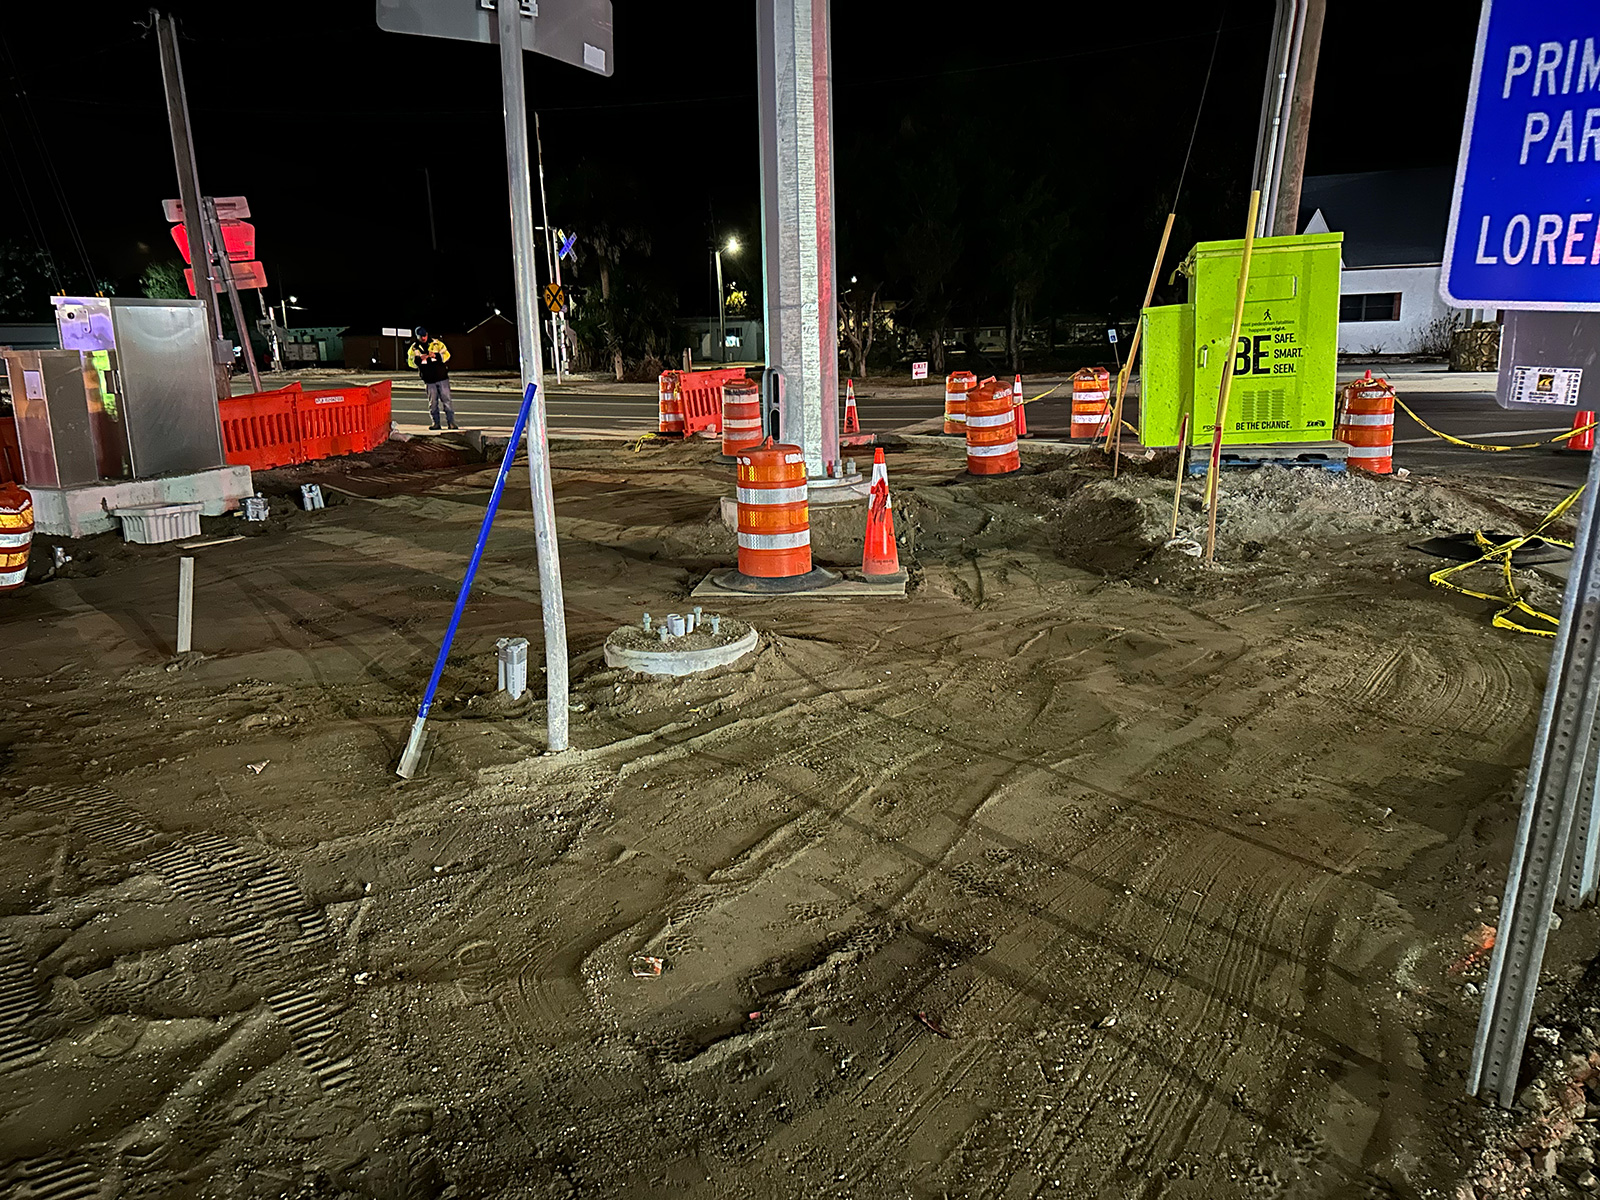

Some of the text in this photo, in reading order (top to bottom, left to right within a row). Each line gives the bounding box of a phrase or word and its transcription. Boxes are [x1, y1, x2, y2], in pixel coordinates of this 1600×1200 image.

[1502, 37, 1600, 99] PRIM
[1519, 107, 1600, 165] PAR
[1475, 213, 1600, 265] LORE
[1274, 333, 1296, 343] SAFE.
[1233, 334, 1272, 376] BE
[1273, 347, 1303, 359] SMART.
[1273, 363, 1296, 374] SEEN.
[1235, 420, 1293, 431] BE THE CHANGE.
